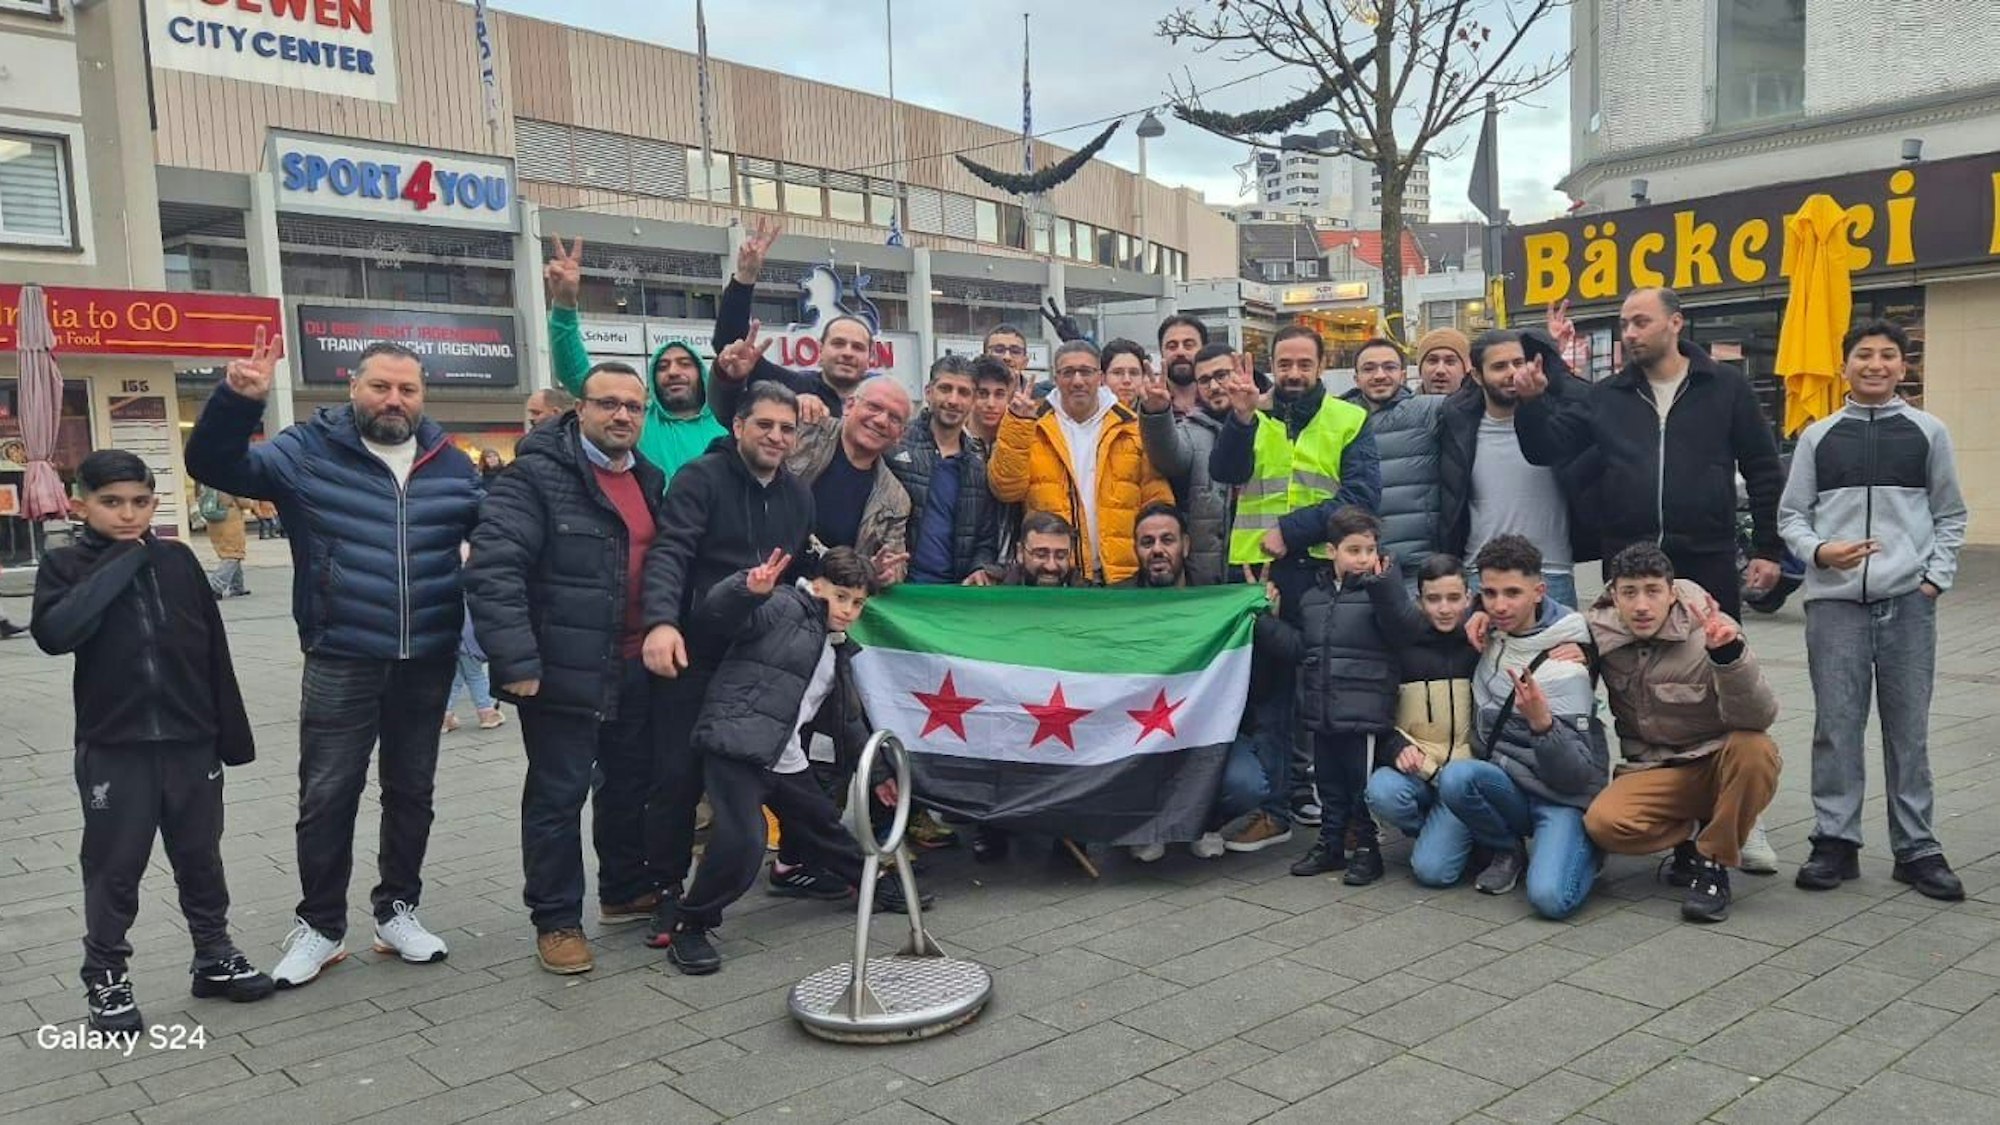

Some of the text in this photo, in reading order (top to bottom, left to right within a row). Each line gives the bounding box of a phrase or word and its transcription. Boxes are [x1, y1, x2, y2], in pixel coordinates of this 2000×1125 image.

[168, 16, 375, 75] CITY CENTER
[282, 151, 506, 211] SPORT4YOU
[1523, 169, 1917, 306] Bäckeei
[87, 302, 117, 329] to
[127, 302, 178, 332] GO
[67, 332, 101, 346] Food
[438, 343, 514, 358] IRGENDWO.
[122, 380, 150, 392] 155
